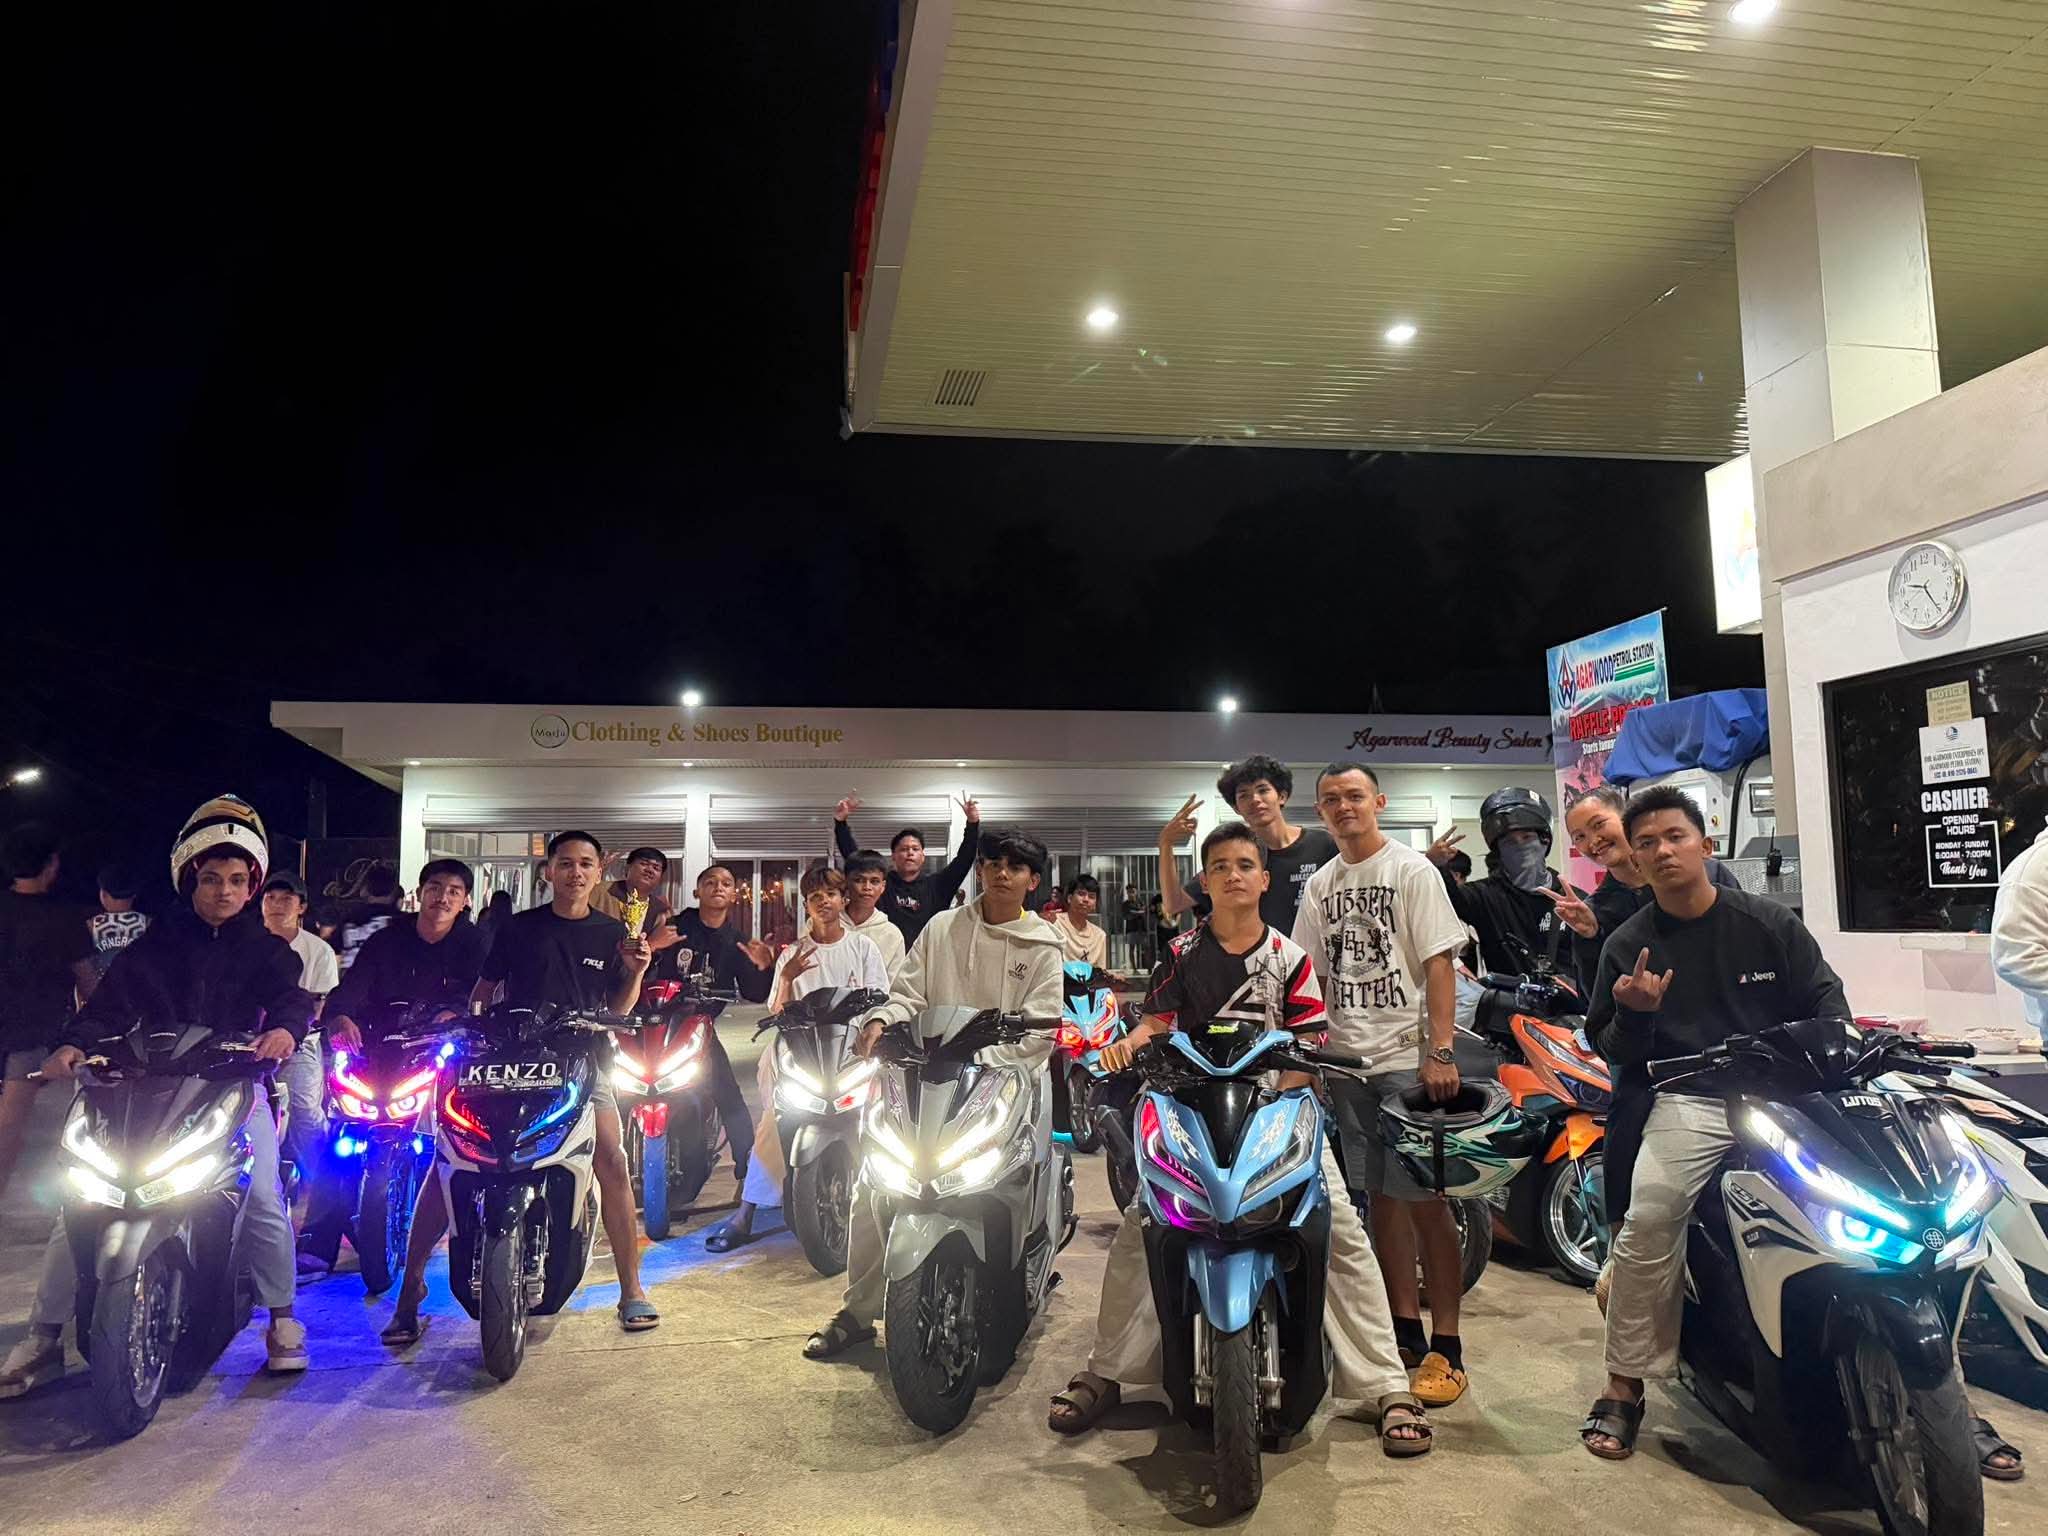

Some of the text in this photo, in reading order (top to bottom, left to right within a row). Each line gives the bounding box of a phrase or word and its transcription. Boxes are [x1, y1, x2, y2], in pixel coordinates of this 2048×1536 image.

[1575, 641, 1655, 690] AGARWOOD PETROL STATION
[1568, 708, 1611, 740] RAFFLE
[572, 720, 844, 748] Clothing & Shoes Boutique
[1346, 726, 1543, 754] Agarwood Beauty Salon
[1921, 786, 1989, 813] CASHIER
[1942, 814, 1979, 826] OPENING
[1946, 825, 1976, 835] HOURS
[1935, 841, 1961, 850] MONDAY
[1964, 840, 1989, 849] SUNDAY
[1965, 849, 1991, 858] 7:00PM
[1939, 861, 1988, 880] Thank You
[1751, 971, 1776, 982] Jeep
[468, 1062, 557, 1081] KENZO
